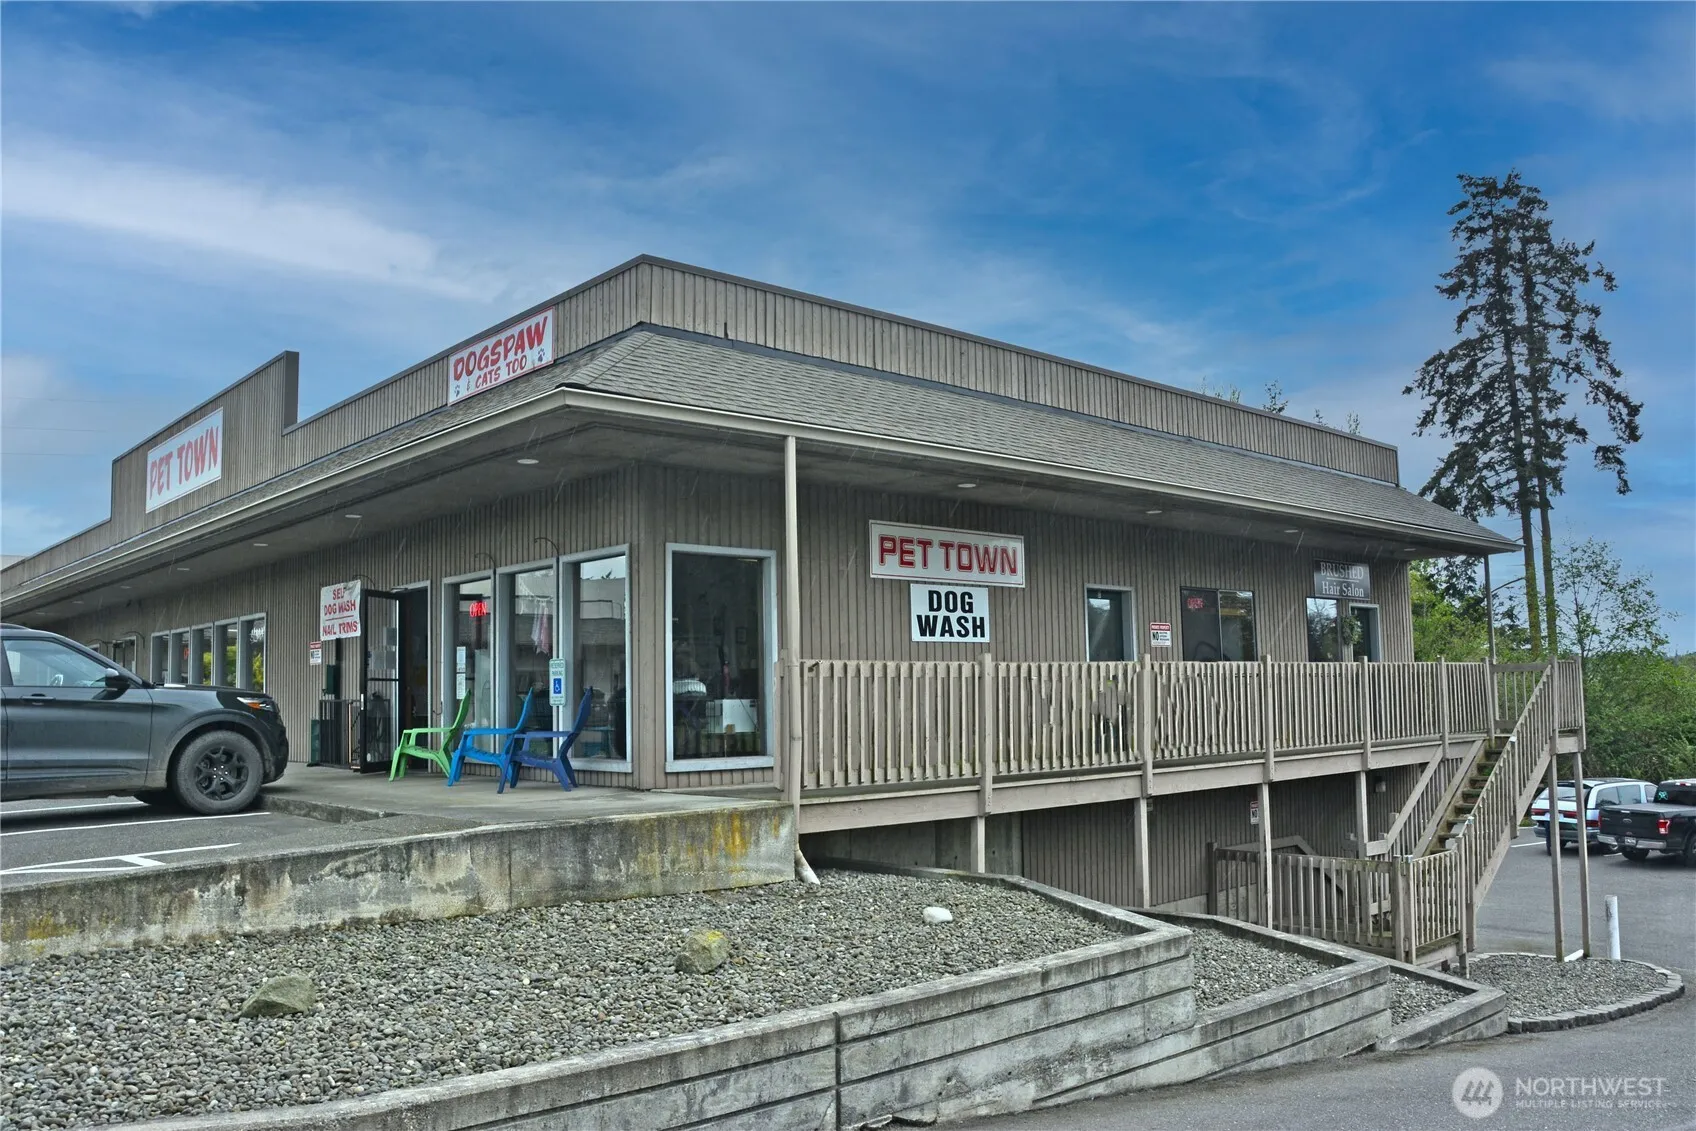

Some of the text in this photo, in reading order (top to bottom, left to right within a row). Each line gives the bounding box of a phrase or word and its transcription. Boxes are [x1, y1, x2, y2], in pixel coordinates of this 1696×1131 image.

[453, 316, 548, 381] DOGSPAW
[475, 366, 501, 389] CATS
[505, 354, 527, 376] TOO
[149, 426, 219, 501] PET TOWN
[878, 534, 1018, 576] PET TOWN
[1320, 561, 1364, 580] BRUSHED
[927, 589, 974, 614] DOG
[1321, 581, 1364, 598] Hair Salon
[324, 599, 356, 616] DOG WASH
[469, 601, 488, 617] OPEN
[322, 620, 358, 636] NAIL TRIMS
[916, 614, 986, 638] WASH
